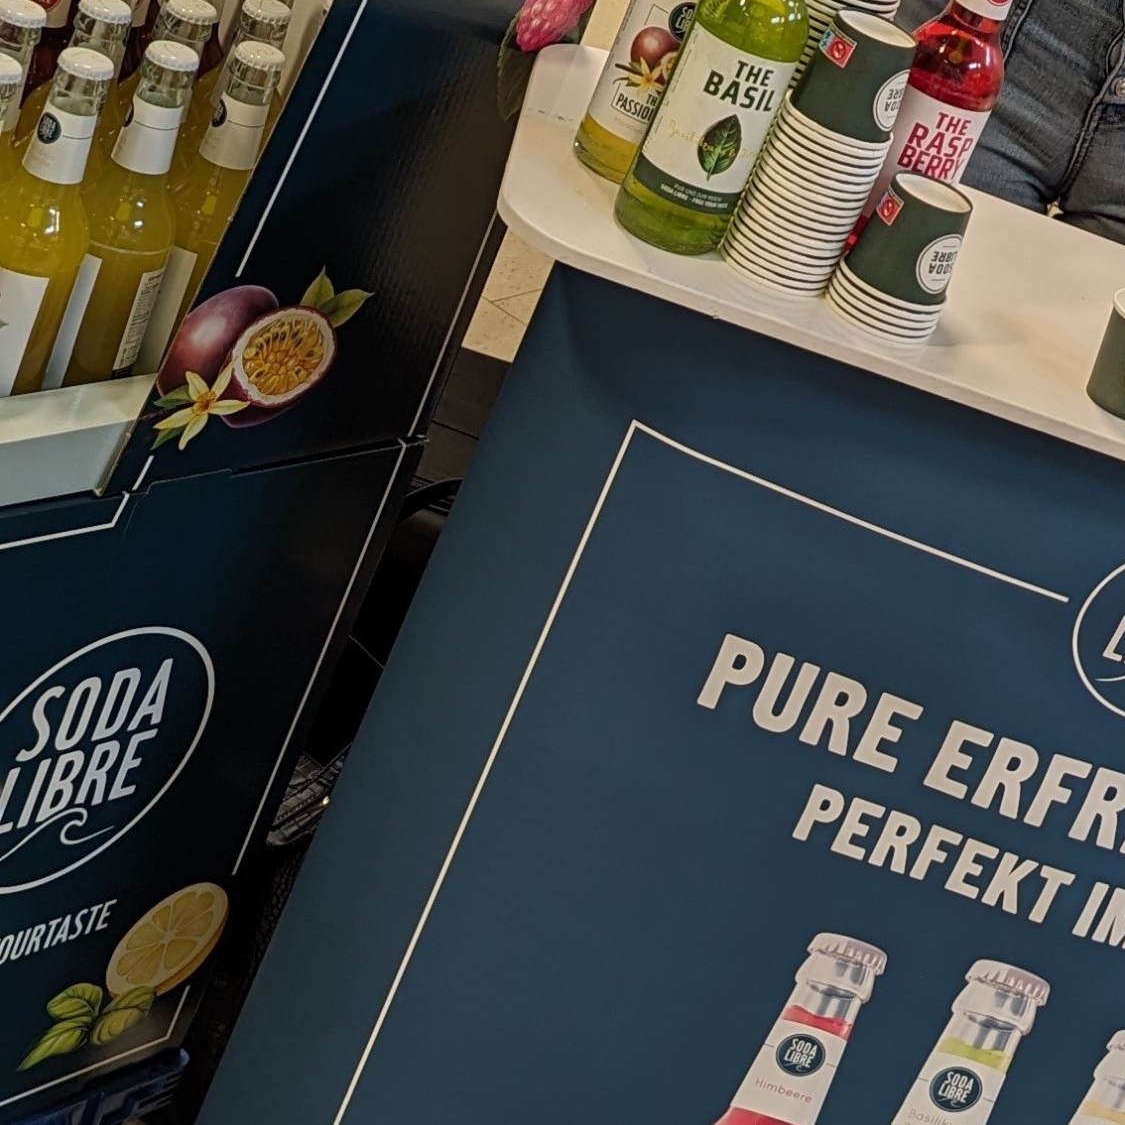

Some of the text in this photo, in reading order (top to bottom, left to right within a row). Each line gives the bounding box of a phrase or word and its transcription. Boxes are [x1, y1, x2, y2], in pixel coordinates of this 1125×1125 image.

[703, 69, 776, 113] BASIL
[735, 60, 775, 87] THE
[907, 122, 974, 159] RASP
[935, 111, 972, 136] THE
[897, 143, 965, 180] BERRY
[16, 658, 174, 762] SODA
[695, 633, 925, 774] PURE
[0, 727, 158, 835] LIBRE
[791, 782, 1076, 924] PERFEKT
[0, 898, 117, 966] OURTASTE
[783, 1048, 814, 1069] LIBRE
[789, 1038, 818, 1057] SODA
[755, 1078, 812, 1103] Himbeere
[937, 1082, 971, 1104] LIBRE
[944, 1071, 975, 1092] SODA
